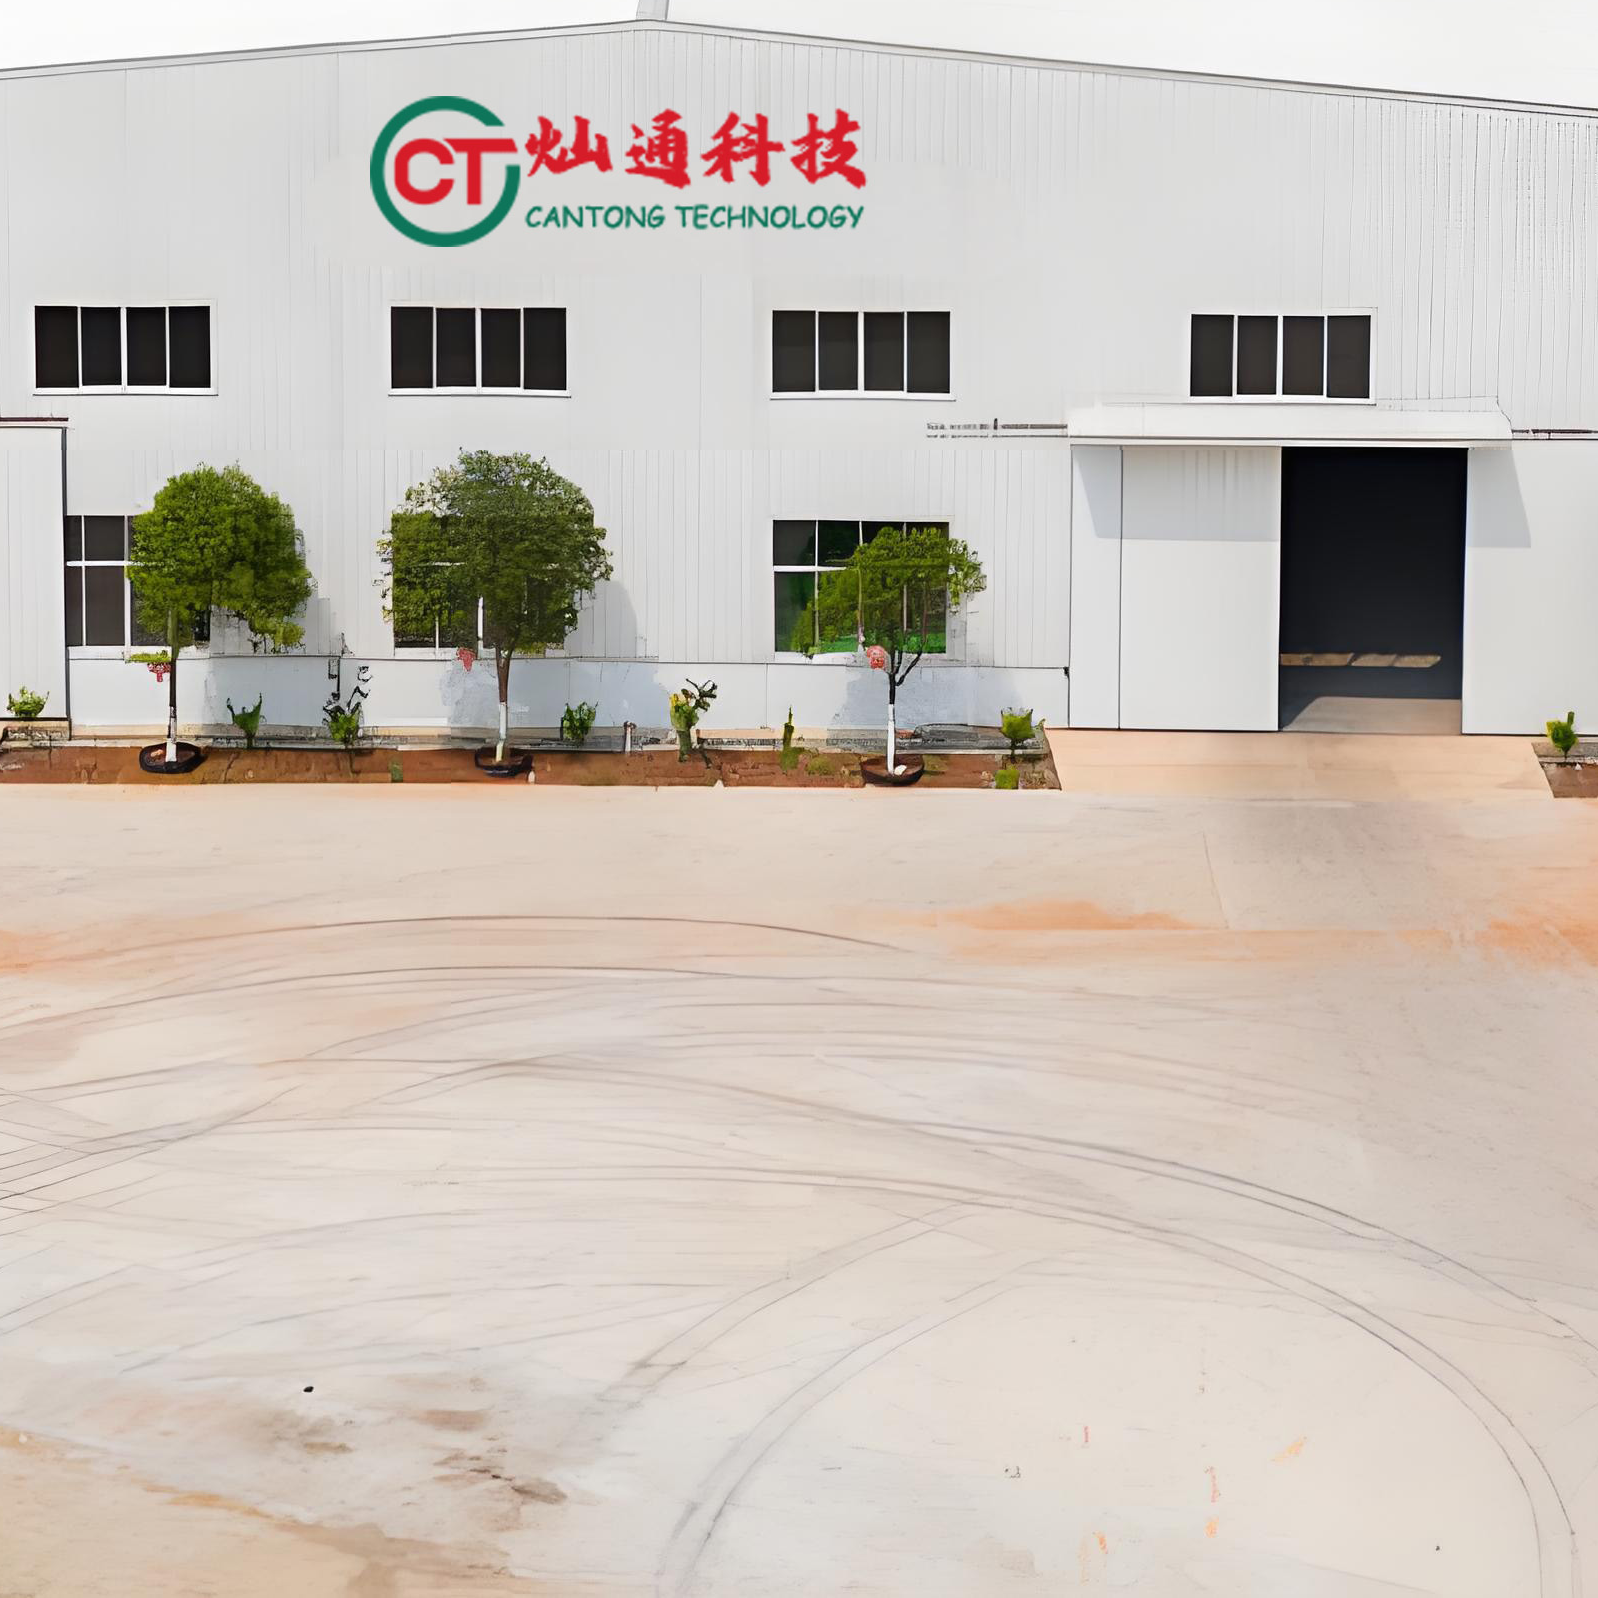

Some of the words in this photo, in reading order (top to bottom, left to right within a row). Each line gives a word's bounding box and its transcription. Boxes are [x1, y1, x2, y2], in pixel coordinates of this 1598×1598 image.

[393, 137, 519, 206] CT
[524, 108, 867, 190] 灿通科技
[524, 204, 666, 230] CANTONG
[674, 204, 866, 230] TECHNOLOGY
